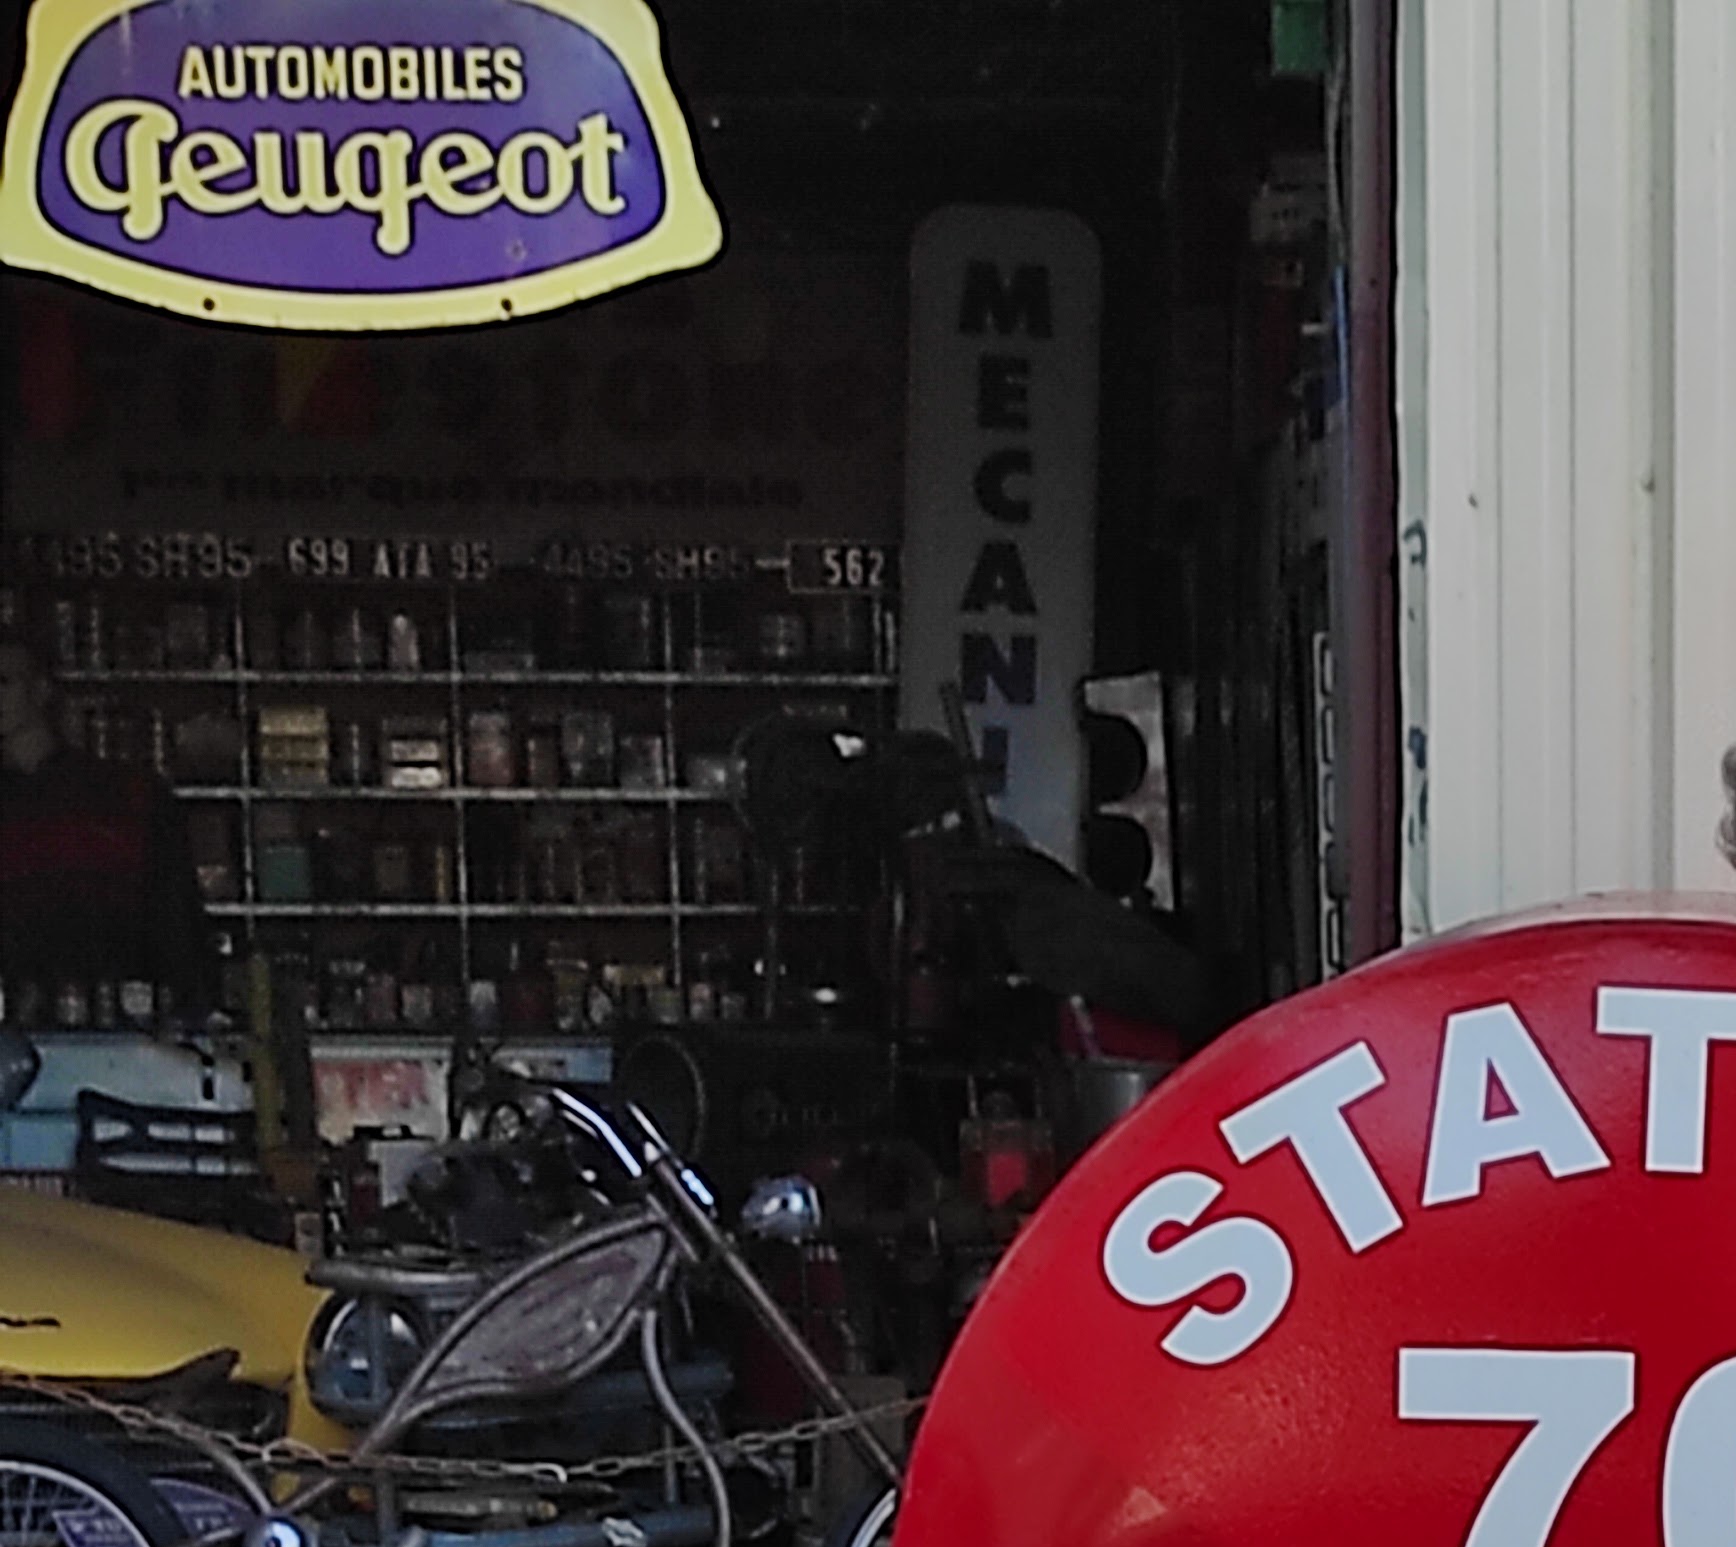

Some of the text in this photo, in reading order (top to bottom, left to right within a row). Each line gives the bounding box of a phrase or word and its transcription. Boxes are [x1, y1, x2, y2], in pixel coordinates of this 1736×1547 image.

[179, 46, 523, 100] AUTOMOBILES
[64, 100, 627, 256] Peugeot
[287, 537, 350, 576] 699
[822, 546, 886, 587] 562
